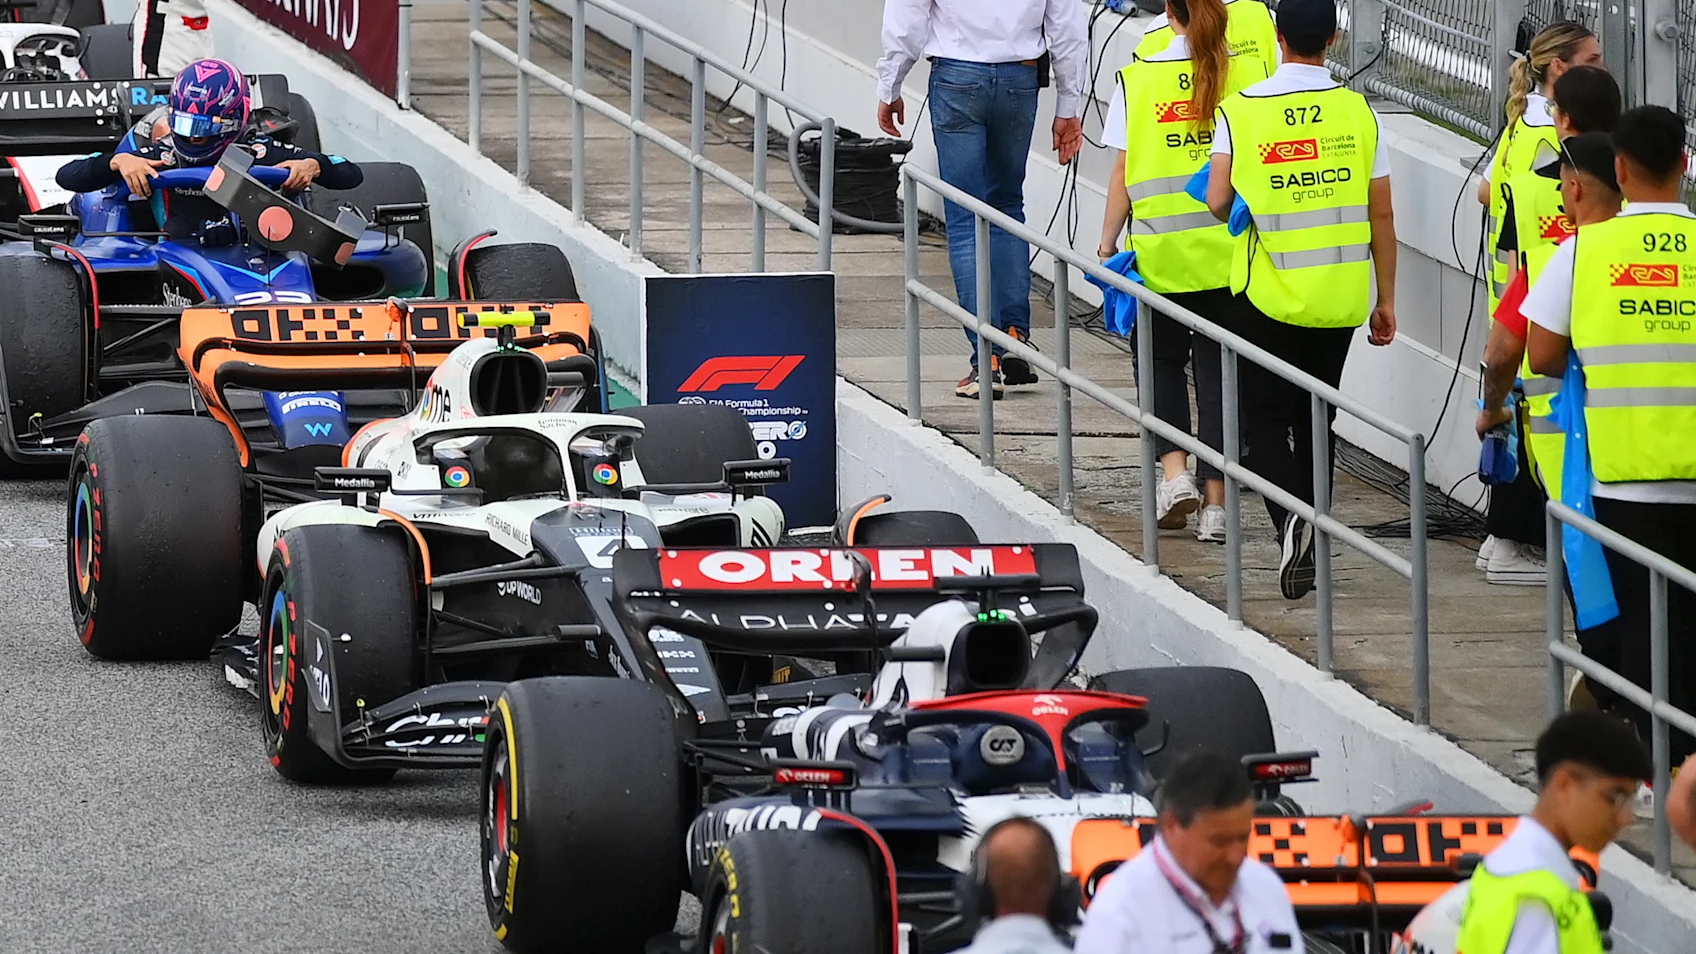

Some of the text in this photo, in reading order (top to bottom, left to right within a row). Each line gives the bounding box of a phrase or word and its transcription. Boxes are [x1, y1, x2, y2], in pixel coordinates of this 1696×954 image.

[1284, 105, 1323, 126] 872
[1320, 134, 1355, 145] Circuit de
[1321, 143, 1356, 152] Barcelona
[1270, 167, 1351, 189] SABICO
[1292, 187, 1334, 204] group
[1642, 233, 1687, 252] 928
[1619, 299, 1696, 316] SABIC
[1644, 319, 1692, 333] group
[725, 398, 762, 408] Formula
[334, 477, 376, 489] Medallia
[744, 469, 781, 480] Medallia
[484, 512, 529, 546] RICHARD MILLE
[698, 548, 996, 583] ORLEN
